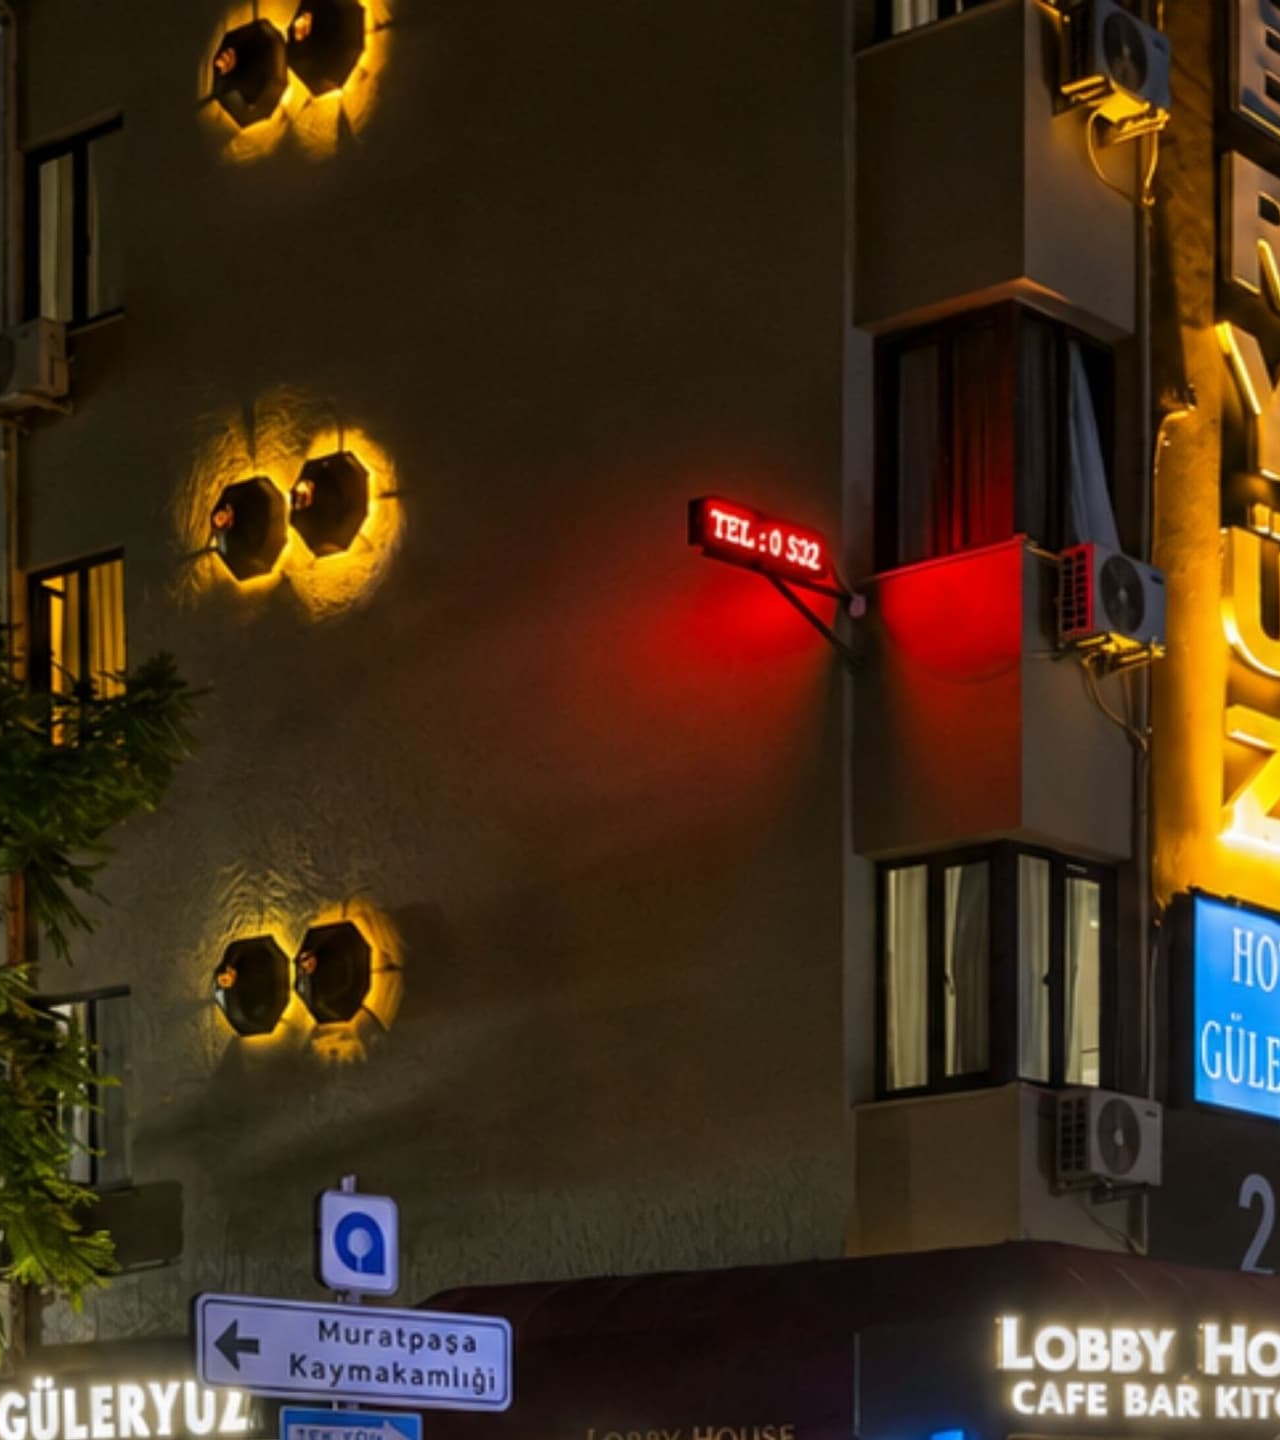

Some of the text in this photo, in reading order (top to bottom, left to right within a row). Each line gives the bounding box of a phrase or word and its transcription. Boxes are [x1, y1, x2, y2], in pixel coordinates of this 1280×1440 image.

[710, 509, 755, 549] TEL
[1238, 1173, 1276, 1275] 2
[318, 1319, 477, 1356] Muratpaşa
[1011, 1380, 1108, 1416] CAFE
[1124, 1383, 1200, 1418] BAR
